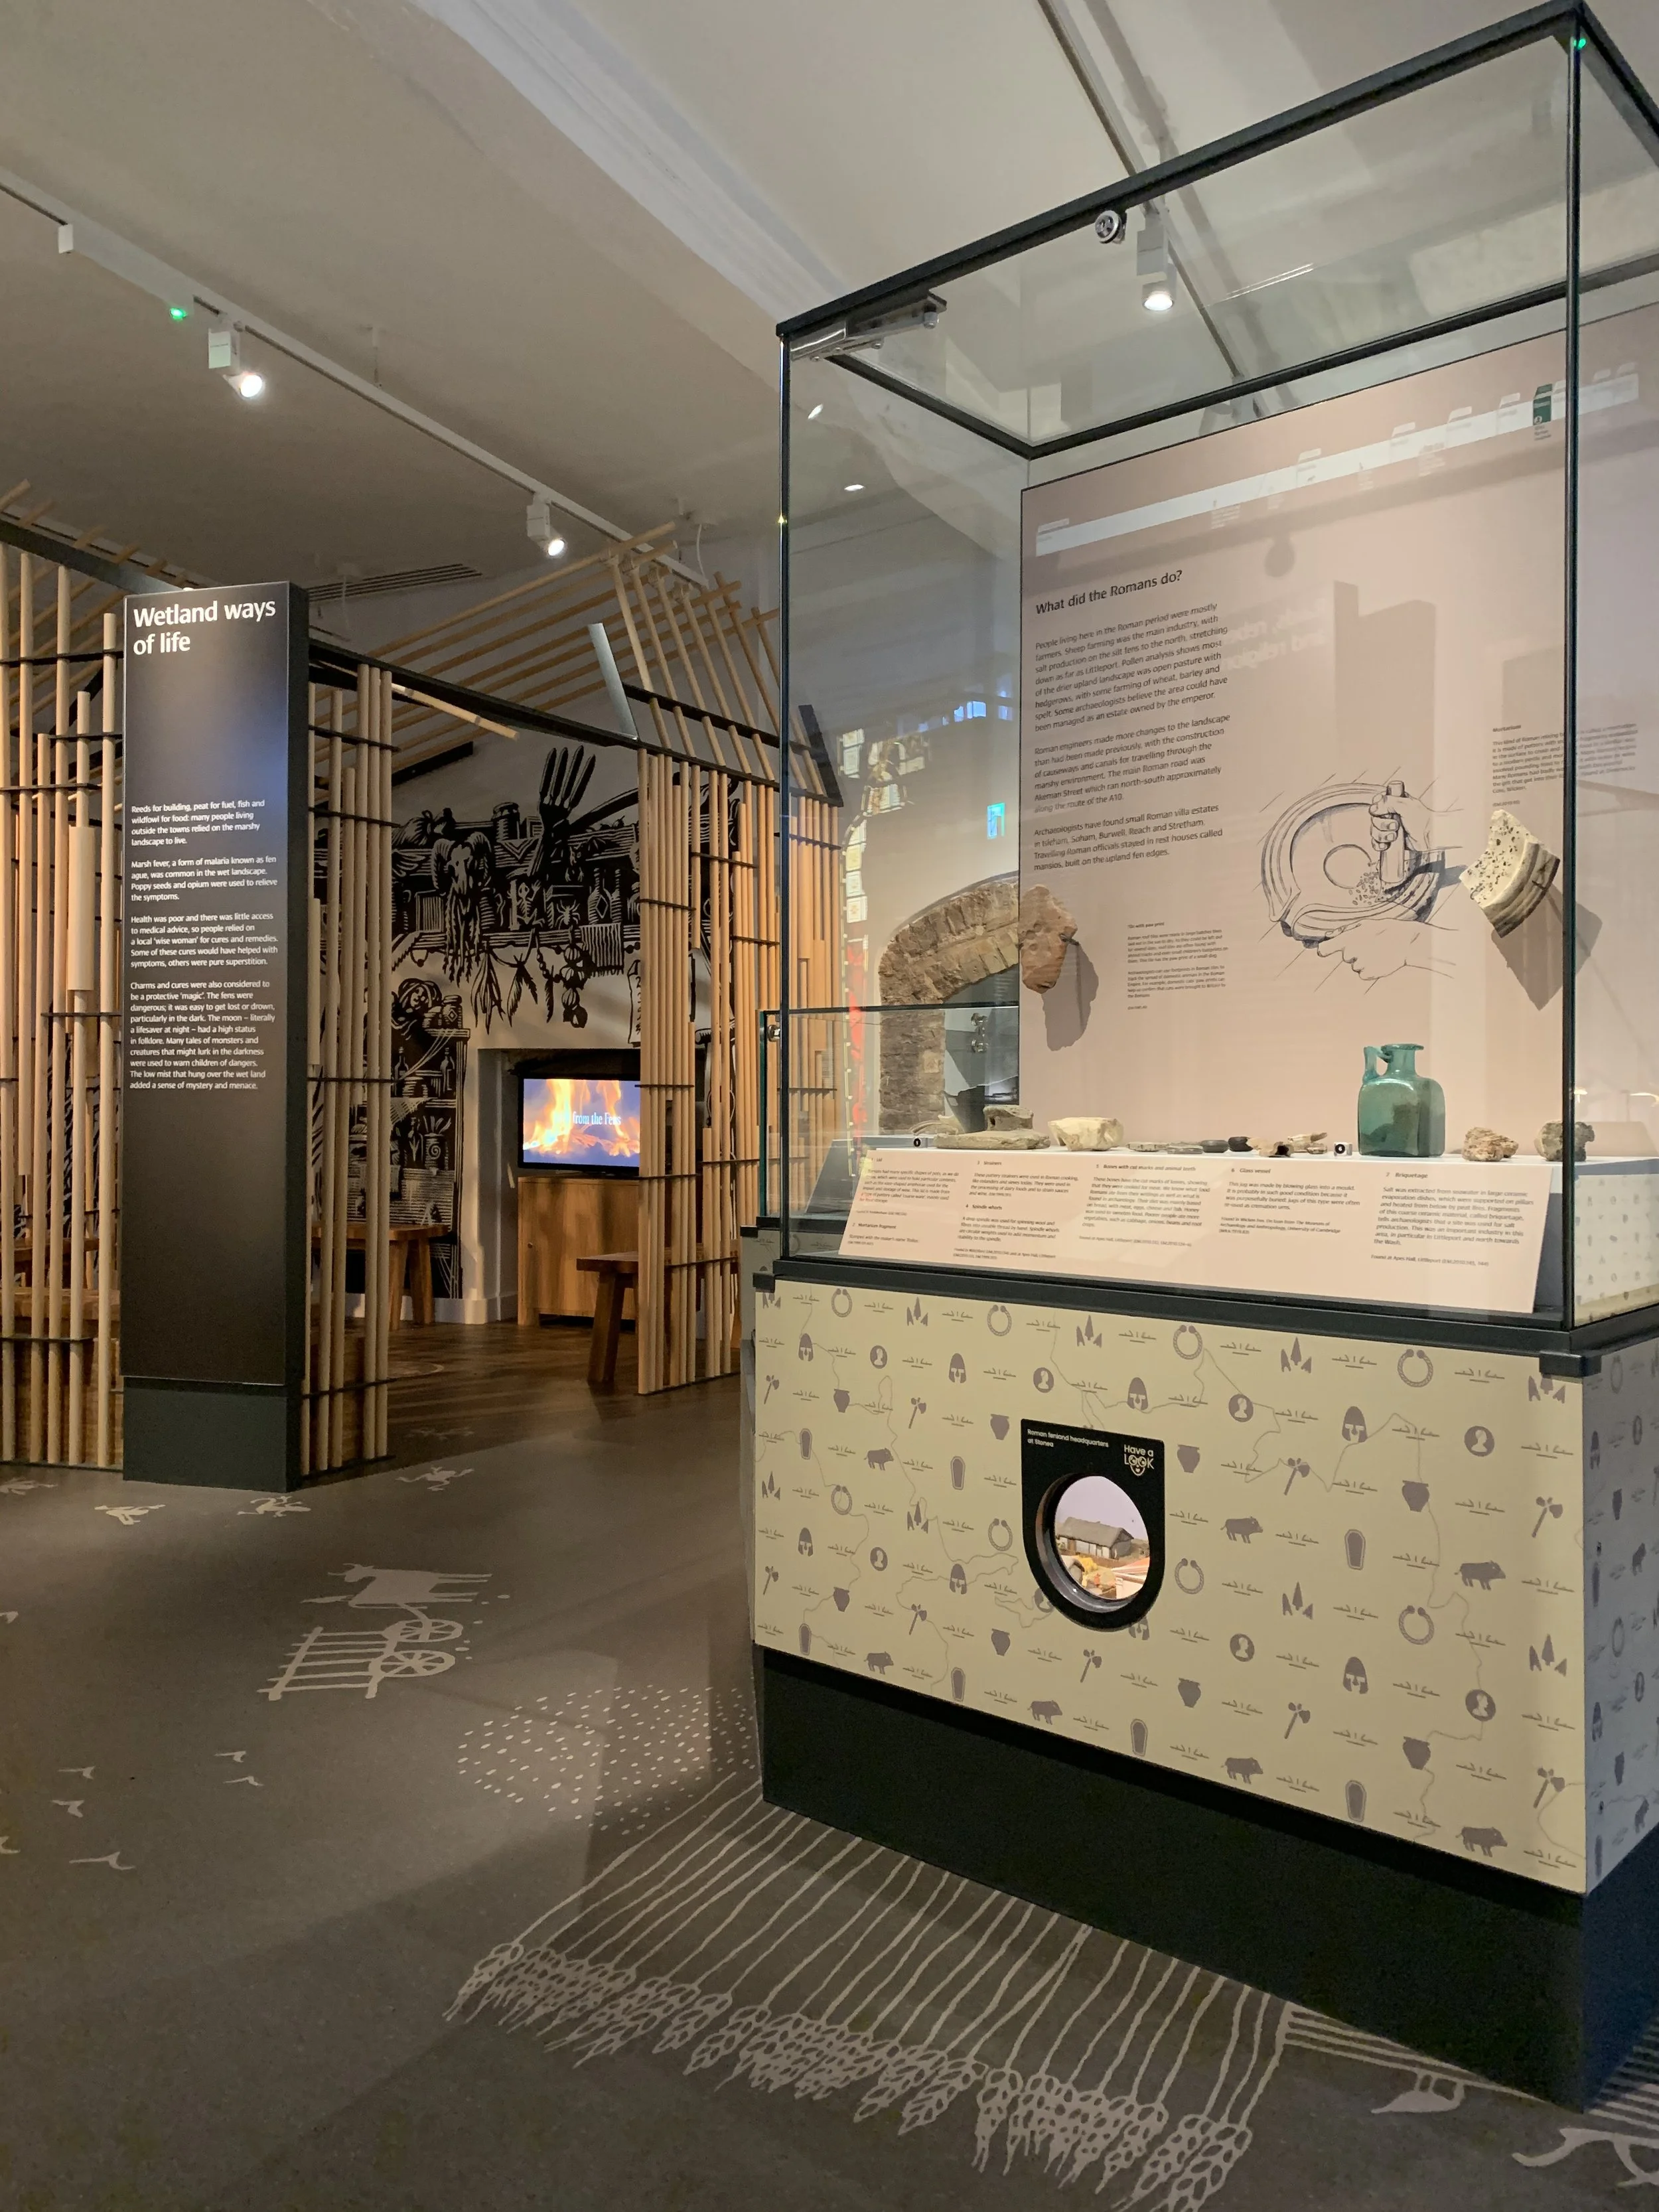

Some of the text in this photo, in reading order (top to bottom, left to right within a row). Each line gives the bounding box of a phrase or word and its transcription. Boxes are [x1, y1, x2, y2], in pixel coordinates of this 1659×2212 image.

[1035, 569, 1183, 614] What did the Romans do?
[133, 600, 276, 628] Wetland ways
[133, 631, 190, 655] of life
[1034, 745, 1058, 755] Roman
[1058, 739, 1092, 751] engineers
[1093, 734, 1114, 744] made
[1115, 731, 1135, 740] more
[1135, 726, 1166, 737] changes
[1176, 721, 1190, 729] the
[1190, 715, 1230, 727] landscape
[1050, 754, 1064, 763] had
[1083, 748, 1104, 758] made
[1144, 737, 1161, 747] with
[1161, 735, 1175, 744] the
[1175, 728, 1224, 741] construction
[1034, 769, 1042, 778] of
[1042, 765, 1079, 776] causeways
[1080, 761, 1094, 770] and
[1094, 757, 1118, 768] canals
[1131, 750, 1165, 761] travelling
[1165, 743, 1197, 756] through
[1198, 741, 1212, 750] the
[1034, 778, 1059, 790] marshy
[1107, 769, 1121, 777] The
[1122, 765, 1141, 774] main
[1141, 763, 1169, 772] Roman
[1169, 757, 1189, 767] road
[1034, 792, 1062, 801] Akeman
[1062, 786, 1083, 796] Street
[1084, 782, 1106, 793] which
[1119, 773, 1165, 787] north-south
[1165, 766, 1221, 781] approximately
[192, 802, 208, 811] peat
[210, 812, 234, 821] people
[235, 811, 253, 820] living
[234, 822, 260, 830] marshy
[200, 924, 224, 933] people
[237, 946, 261, 954] helped
[130, 959, 167, 968] symptoms,
[225, 957, 267, 966] superstition.
[573, 1111, 590, 1124] from
[591, 1112, 603, 1125] the
[605, 1112, 622, 1126] Fens
[1027, 1428, 1109, 1447] Roman fenland headquarters
[1034, 1438, 1054, 1447] Stonea
[1123, 1444, 1147, 1456] Have
[1123, 1453, 1155, 1469] LOOK
